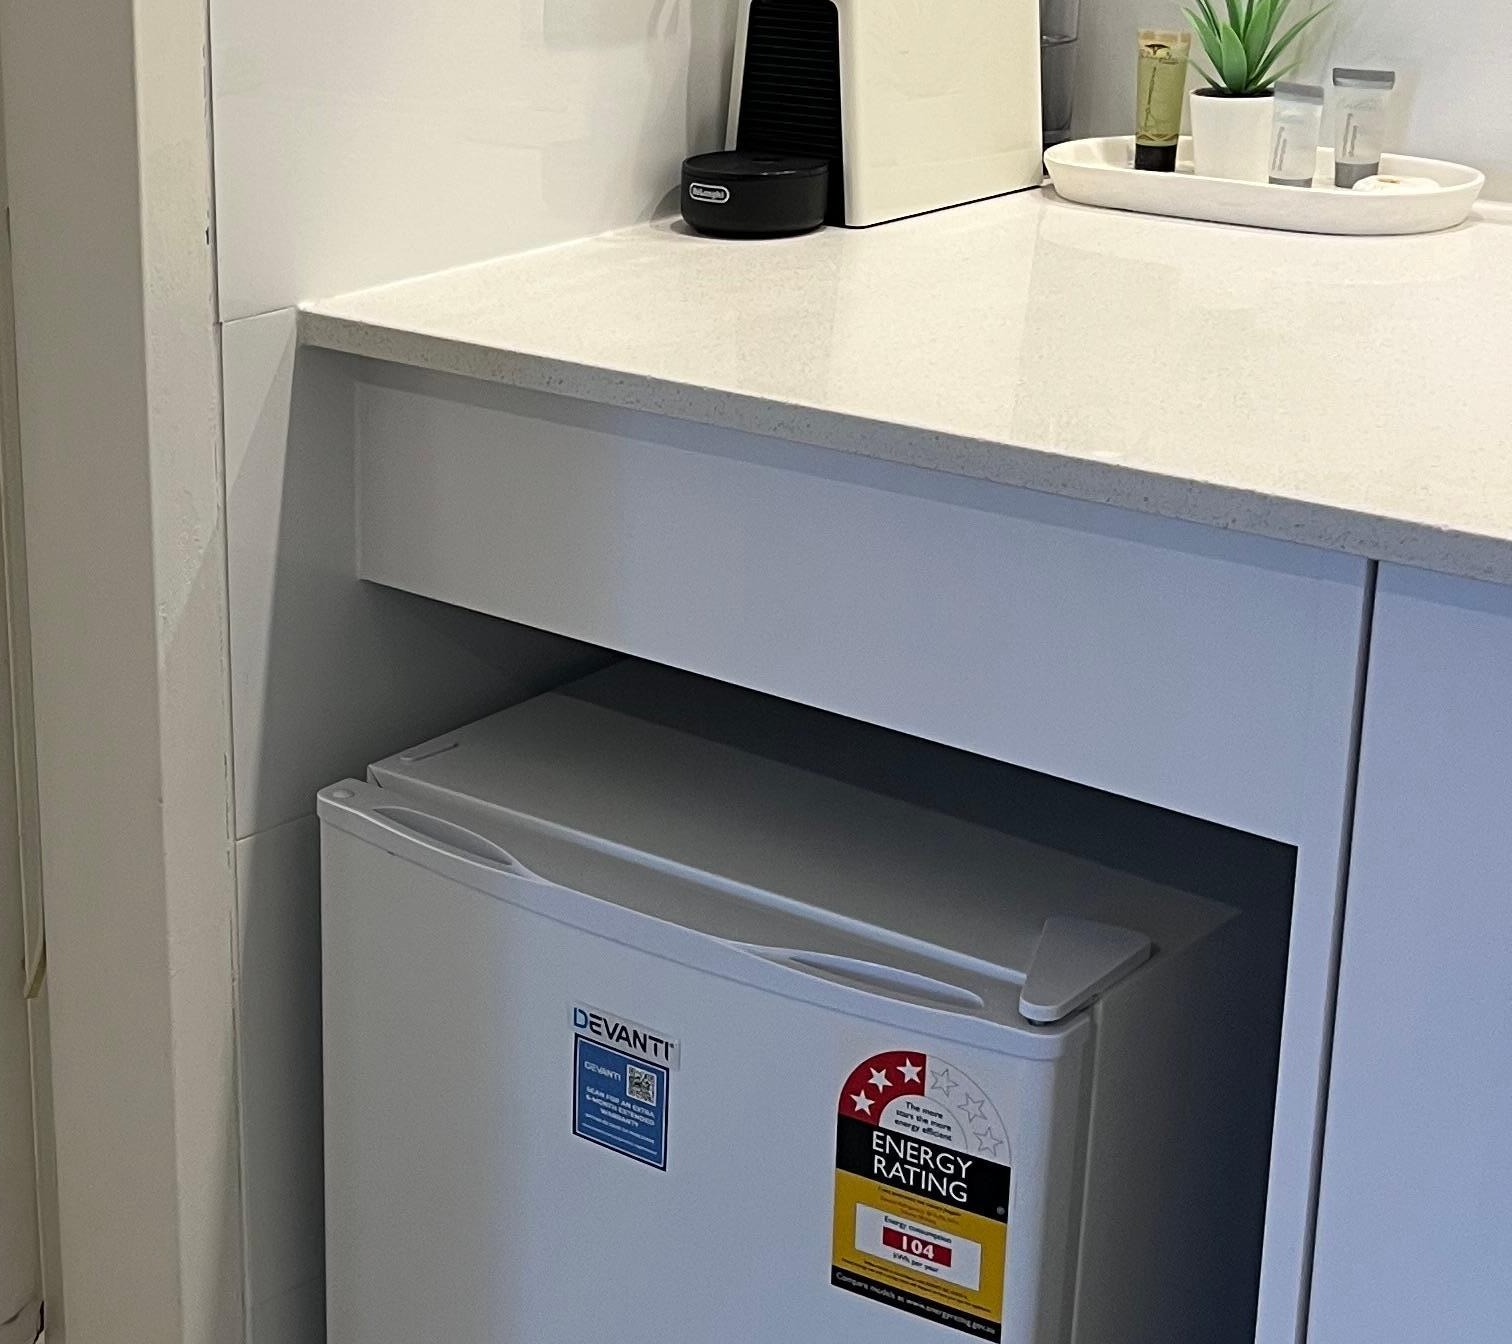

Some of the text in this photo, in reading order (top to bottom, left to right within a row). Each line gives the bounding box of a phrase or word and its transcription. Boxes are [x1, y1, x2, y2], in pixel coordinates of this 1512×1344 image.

[574, 1007, 669, 1061] DEVANTI
[584, 1061, 621, 1081] DEVANTI
[905, 1101, 944, 1119] The more
[894, 1119, 920, 1132] energy
[916, 1115, 929, 1124] the
[930, 1120, 952, 1132] more
[872, 1130, 973, 1179] ENERGY
[873, 1154, 968, 1203] RATING
[884, 1215, 907, 1230] Energy
[902, 1235, 935, 1260] 104
